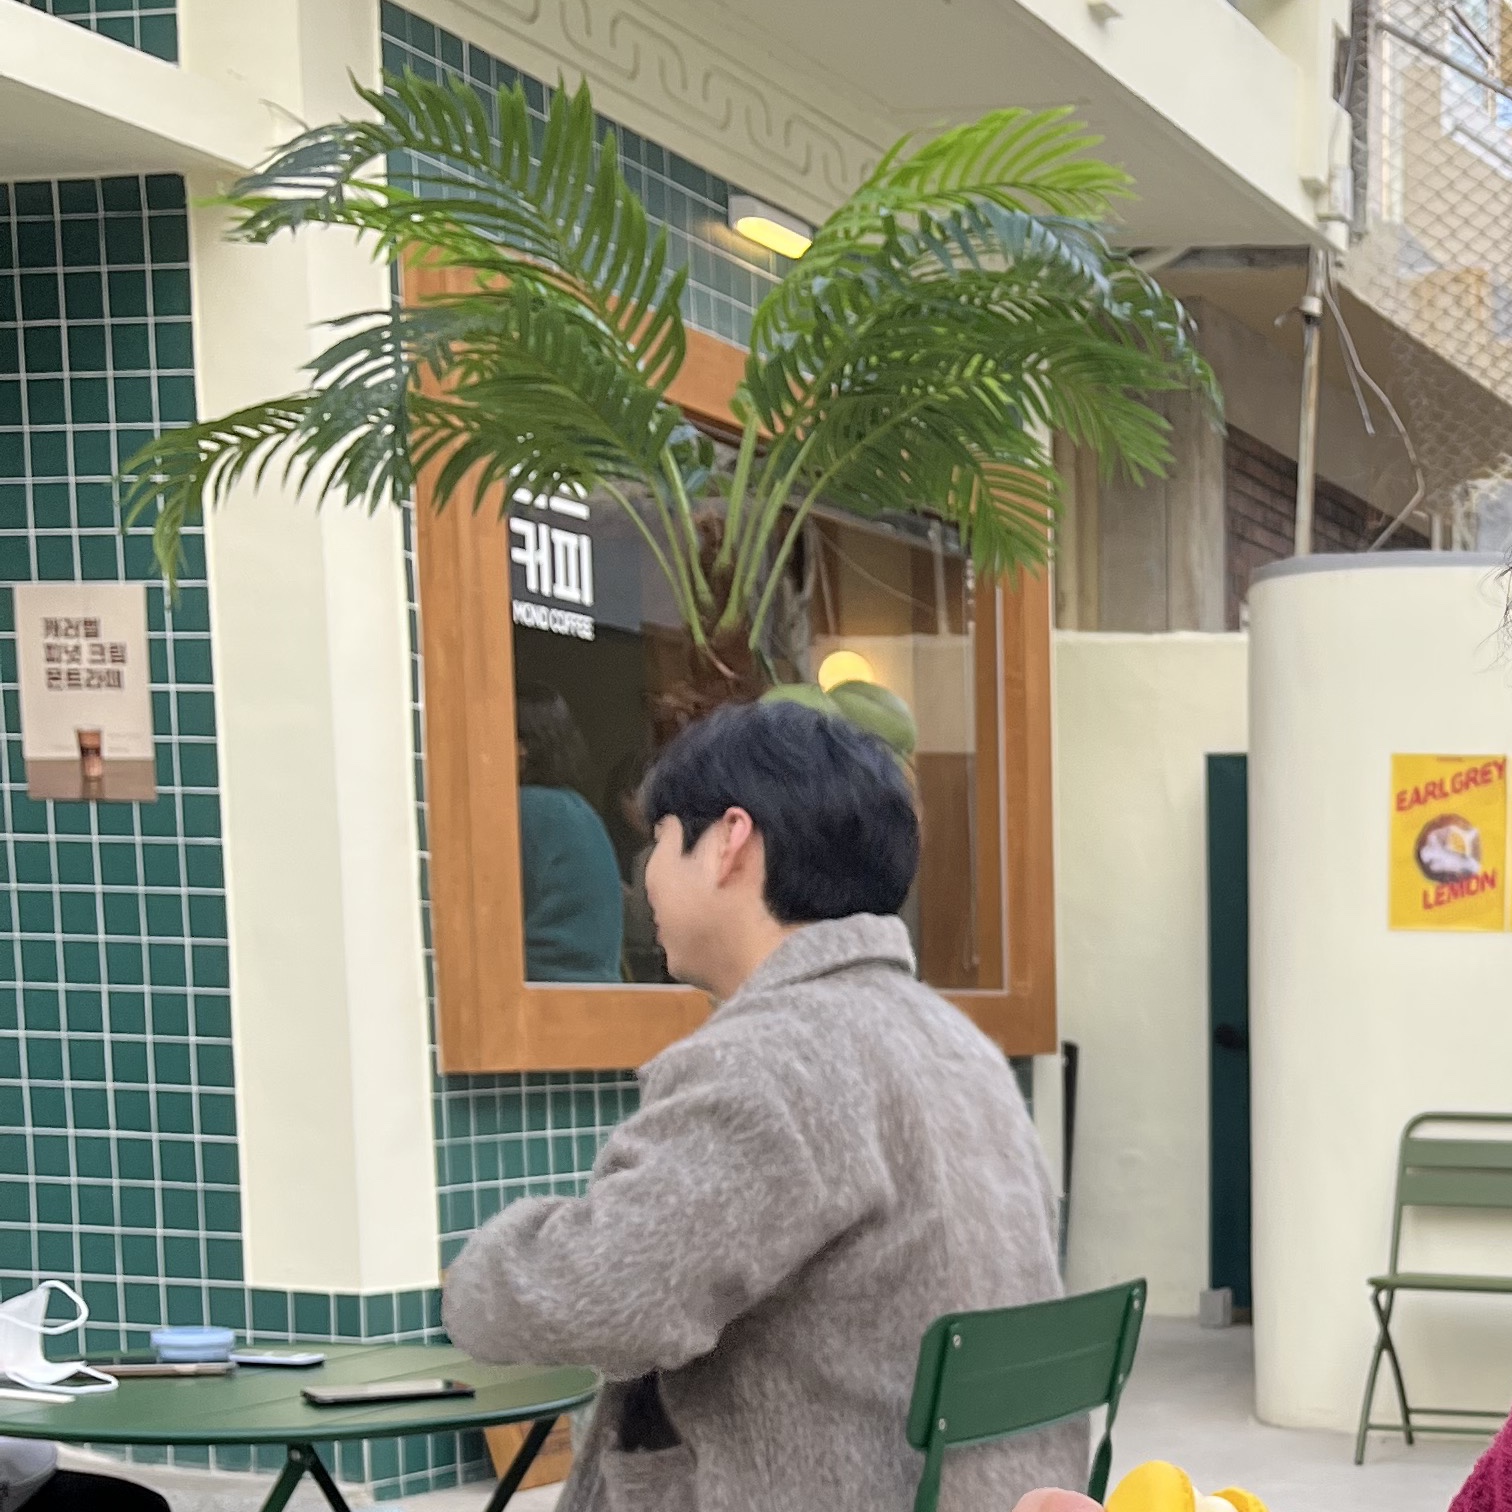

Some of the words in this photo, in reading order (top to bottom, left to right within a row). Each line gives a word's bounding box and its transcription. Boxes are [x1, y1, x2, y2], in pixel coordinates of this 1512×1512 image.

[509, 516, 595, 607] 커피
[512, 599, 549, 632] MOND
[550, 607, 596, 642] COFFEE
[89, 642, 126, 664] 크림
[1422, 870, 1497, 910] LEMON
